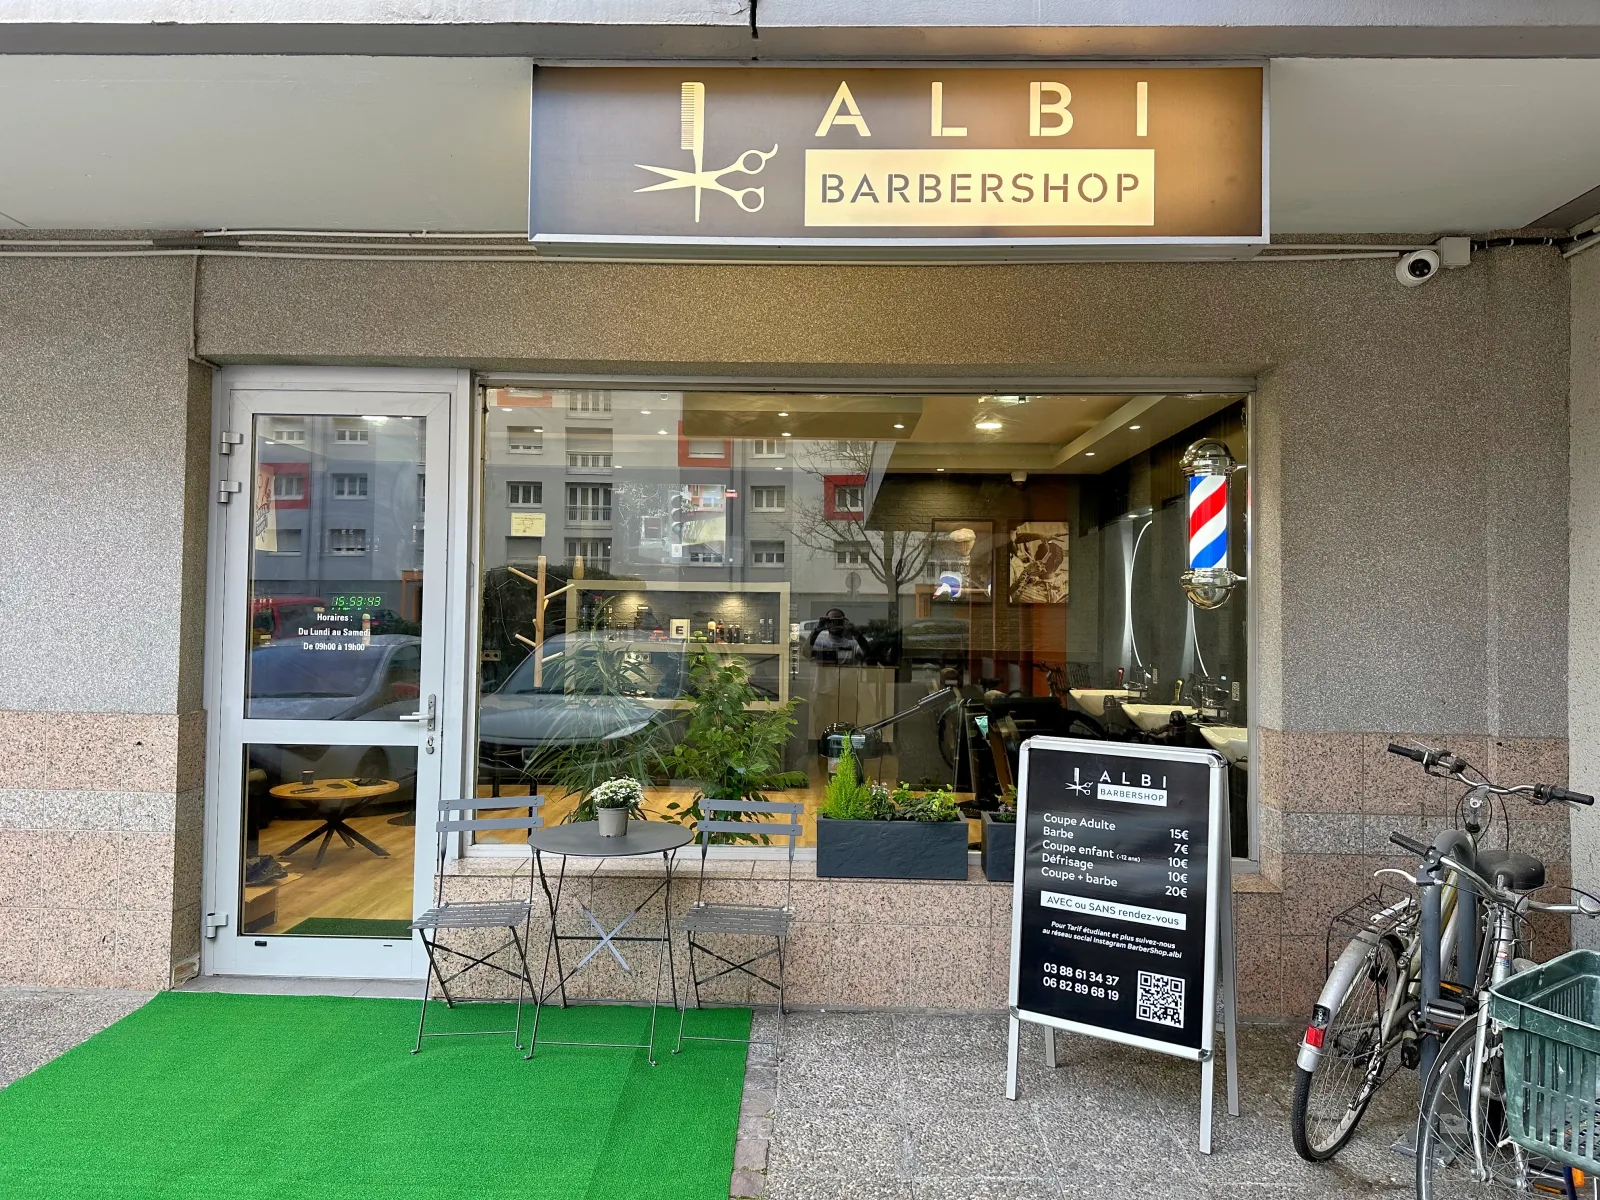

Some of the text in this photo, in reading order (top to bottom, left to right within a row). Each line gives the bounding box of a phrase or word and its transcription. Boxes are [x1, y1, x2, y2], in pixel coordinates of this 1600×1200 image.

[814, 80, 1148, 137] ALBI
[820, 172, 1140, 203] BARBERSHOP
[298, 628, 308, 636] Du
[310, 628, 330, 636] Lundi
[343, 628, 371, 637] Samedi
[676, 626, 684, 634] E
[303, 642, 365, 651] De 09h00 à 19h00
[1100, 770, 1166, 788] ALBI
[1100, 788, 1164, 801] BARBERSHOP
[1043, 813, 1116, 830] Coupe Adulte
[1043, 826, 1074, 838] Barbe
[1170, 828, 1189, 840] 15€
[1042, 840, 1076, 853] Coupe
[1078, 846, 1114, 858] enfant
[1174, 843, 1188, 854] 7€
[1042, 853, 1094, 871] Défrisage
[1168, 856, 1188, 869] 10€
[1041, 867, 1075, 881] Coupe
[1086, 873, 1118, 887] barbe
[1168, 871, 1188, 883] 10€
[1165, 885, 1188, 898] 20€
[1046, 896, 1180, 926] AVEC ou SANS rendez-vous
[1051, 921, 1066, 929] Pour
[1067, 924, 1082, 932] Tarif
[1082, 927, 1111, 938] étudiant
[1135, 937, 1176, 949] suivez-nous
[1051, 930, 1072, 938] réseau
[1073, 934, 1092, 942] social
[1093, 937, 1126, 948] Instagram
[1127, 943, 1182, 958] BarberShop.albi
[1043, 962, 1119, 986] 03 88 61 34 37
[1043, 976, 1119, 1001] 06 82 89 68 19
